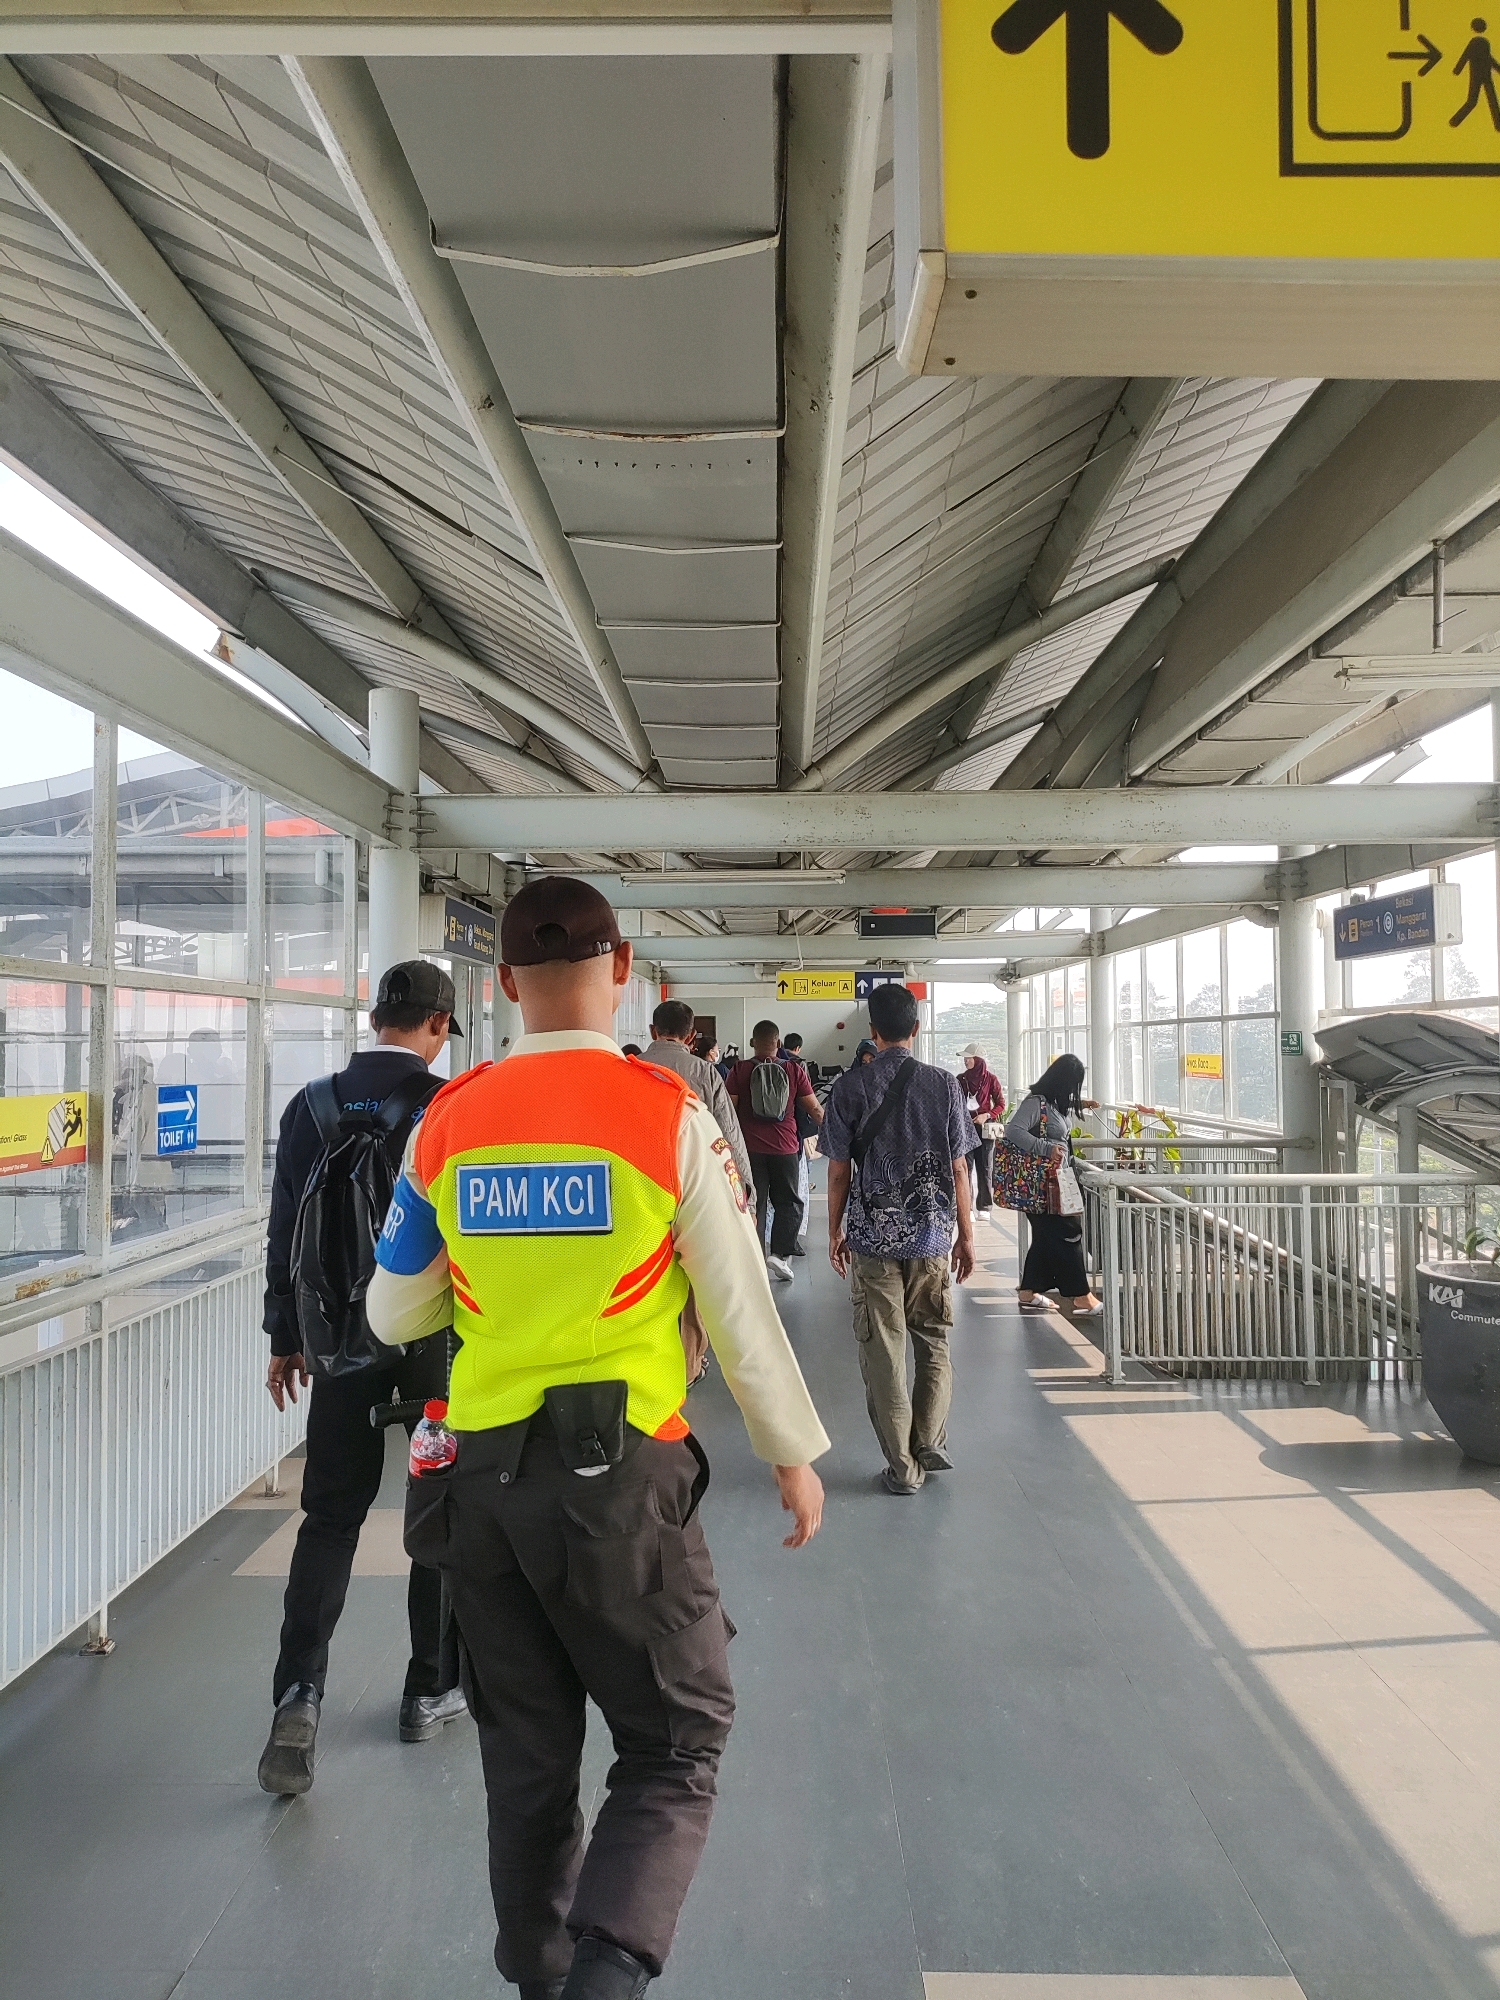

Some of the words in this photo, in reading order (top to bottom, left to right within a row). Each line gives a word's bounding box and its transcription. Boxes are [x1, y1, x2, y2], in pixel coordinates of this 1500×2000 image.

[1396, 909, 1428, 925] Manggarai
[811, 979, 837, 988] Keluar
[842, 982, 850, 991] A
[160, 1130, 185, 1148] TOILET
[469, 1176, 528, 1218] PAM
[543, 1174, 595, 1216] KCI
[1428, 1282, 1464, 1309] KAI
